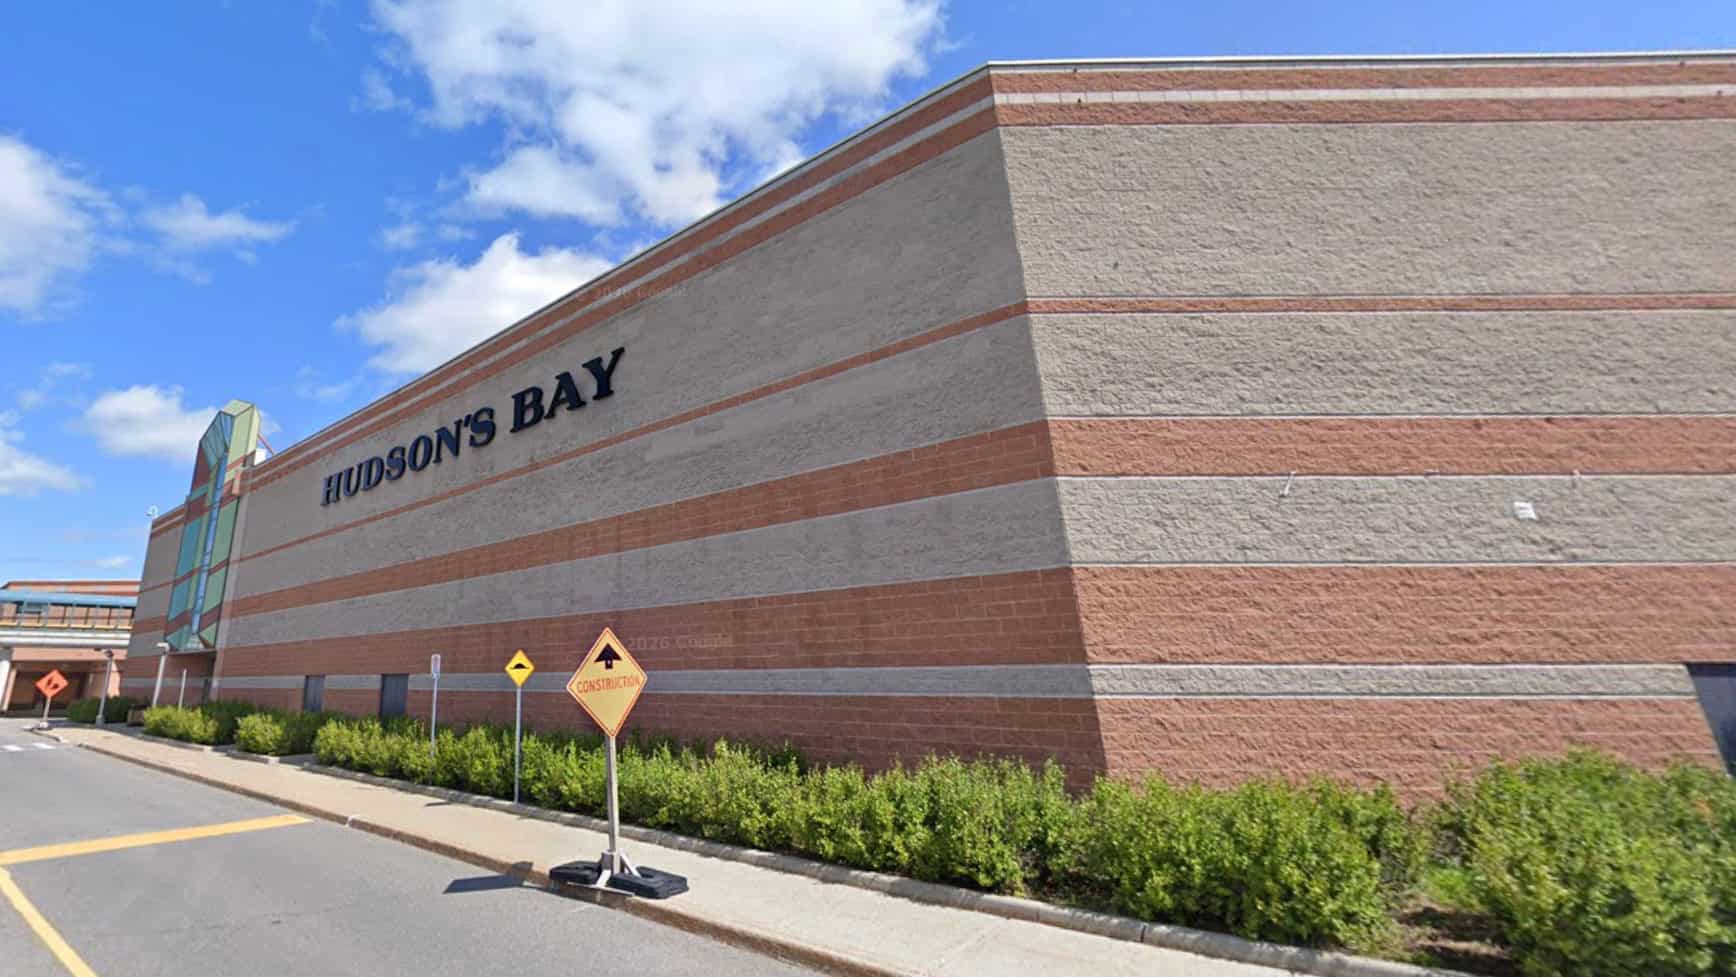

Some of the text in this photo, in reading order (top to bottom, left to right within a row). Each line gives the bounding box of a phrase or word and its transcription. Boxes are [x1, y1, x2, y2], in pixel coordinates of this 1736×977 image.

[320, 347, 625, 506] HUDSON'S BAY
[576, 675, 641, 694] CONSTRUCTION
